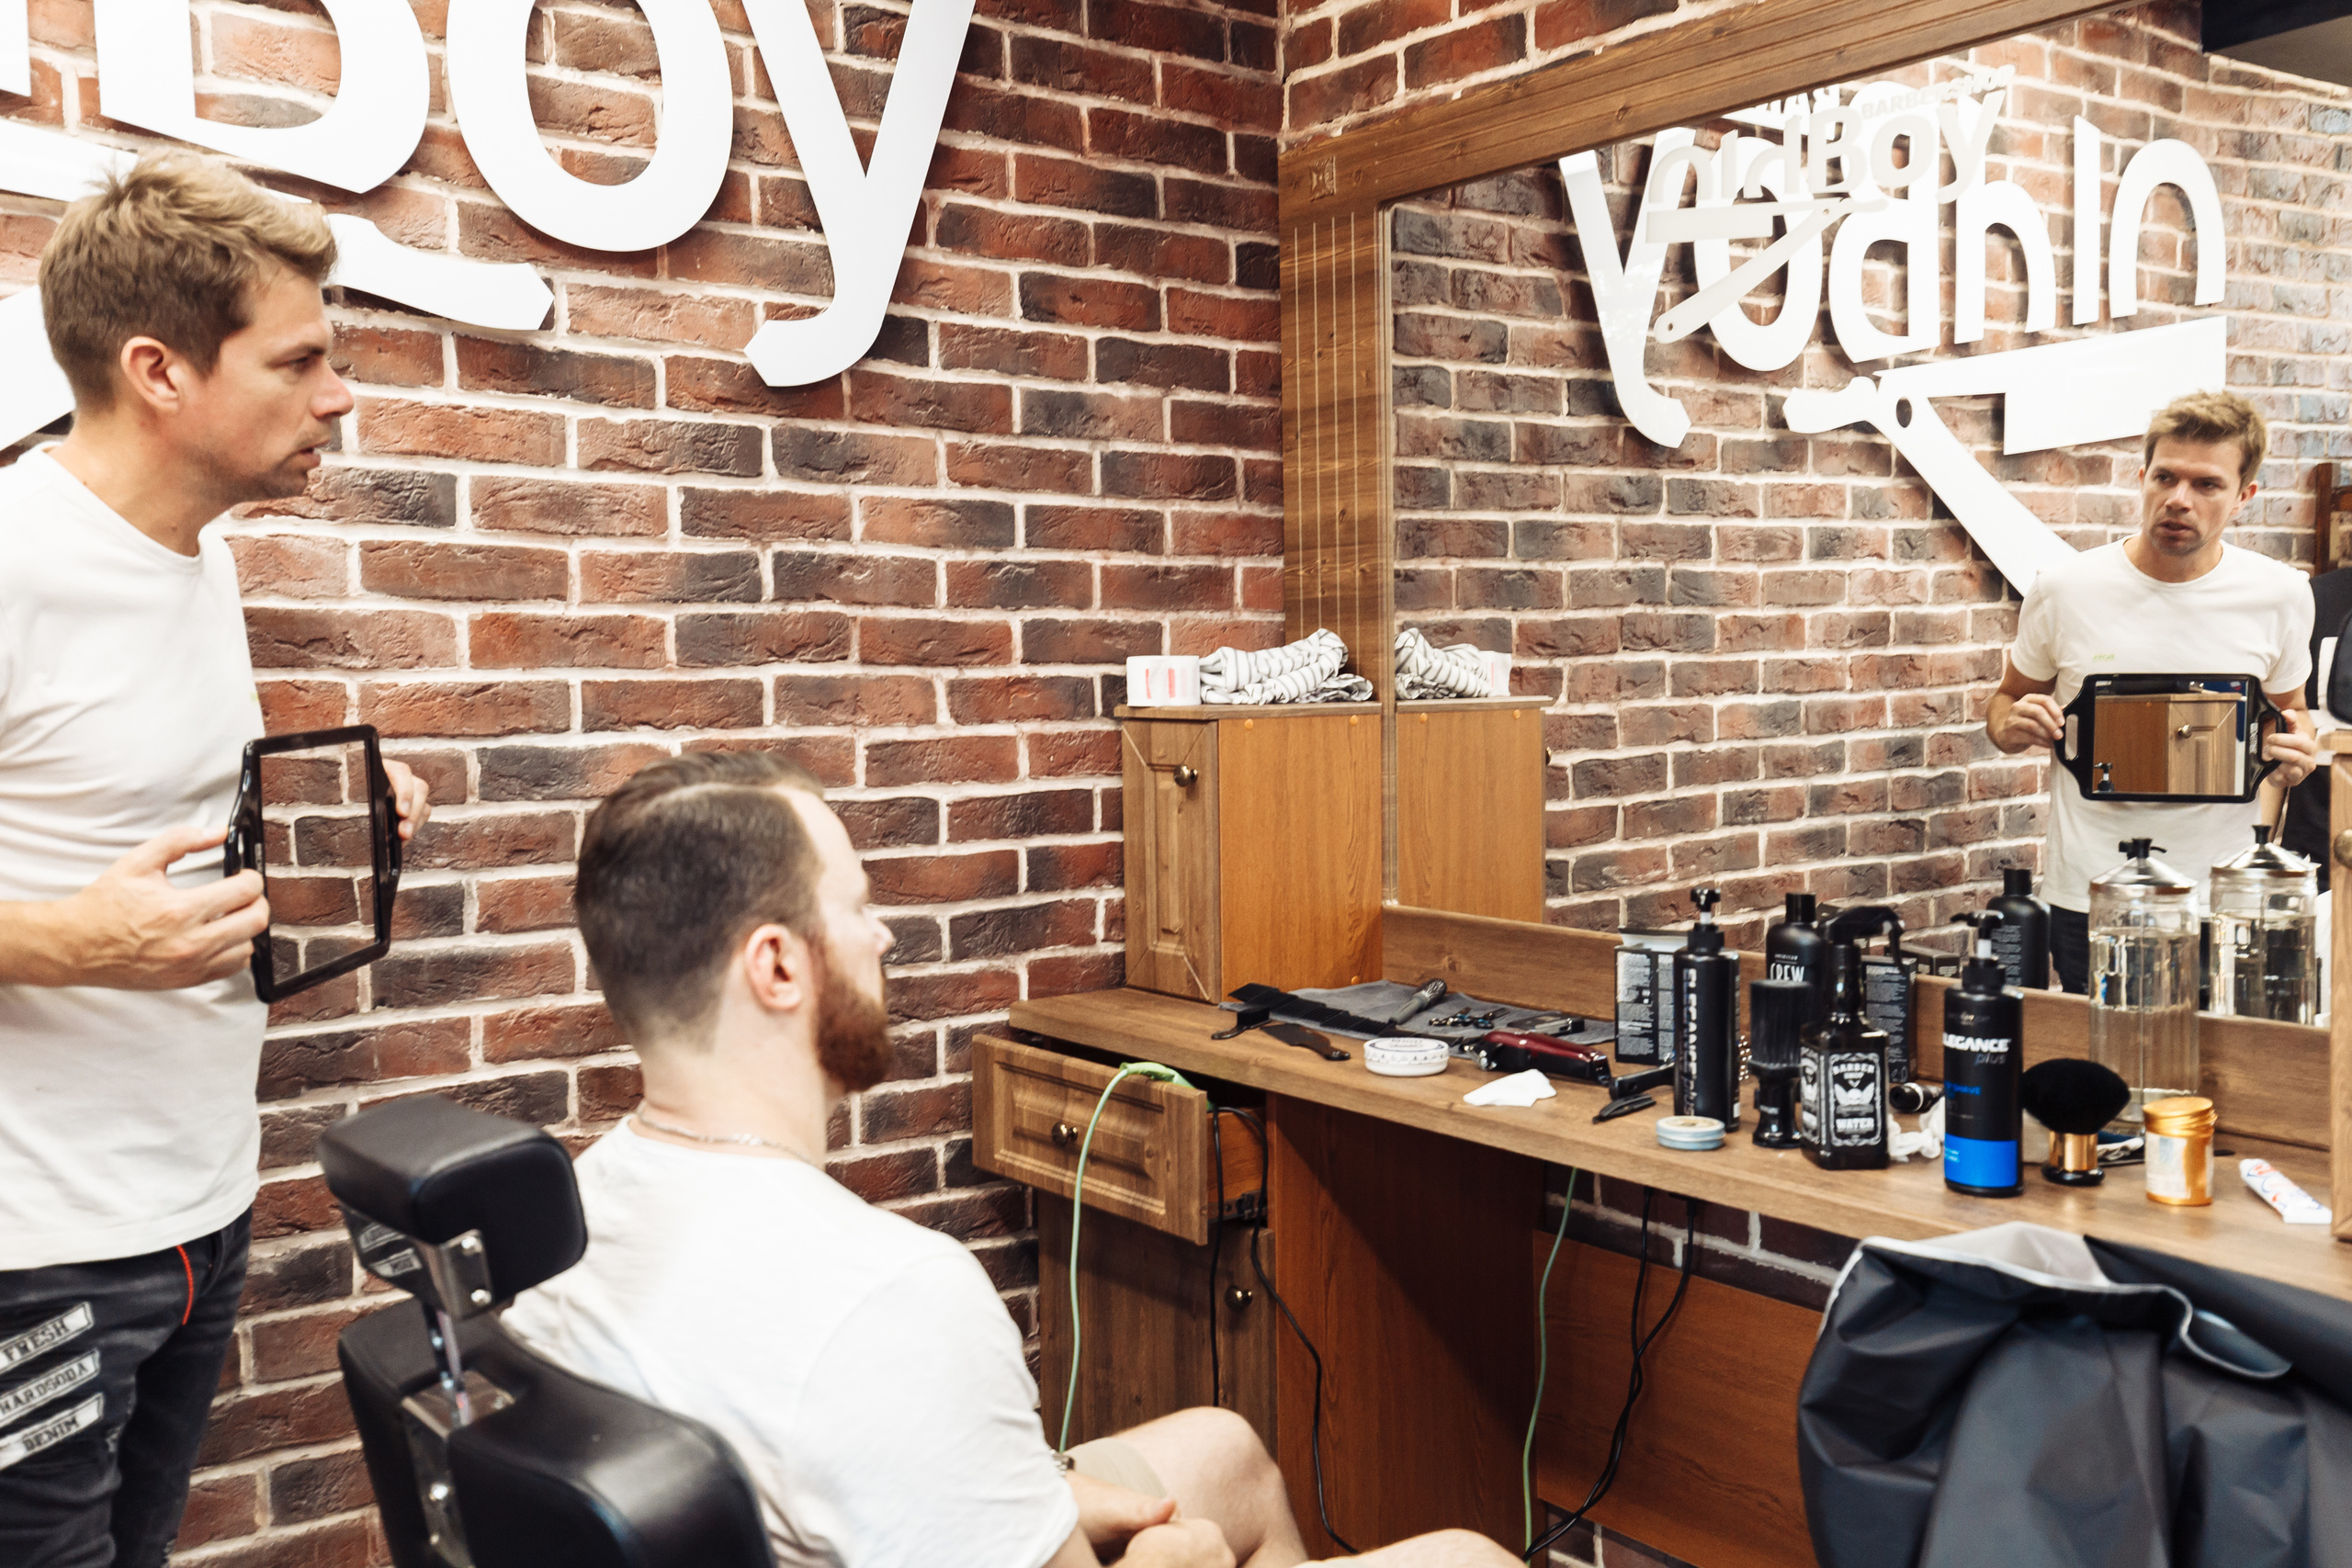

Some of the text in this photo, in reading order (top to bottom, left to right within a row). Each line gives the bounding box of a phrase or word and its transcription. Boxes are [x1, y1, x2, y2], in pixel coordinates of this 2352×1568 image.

[1770, 963, 1804, 982] CREW
[1683, 967, 1697, 1075] ELEGANCE
[1836, 1117, 1874, 1131] WATER
[3, 1318, 71, 1362] FRESH
[0, 1362, 87, 1417] HARDSODA
[21, 1416, 80, 1452] DENIM
